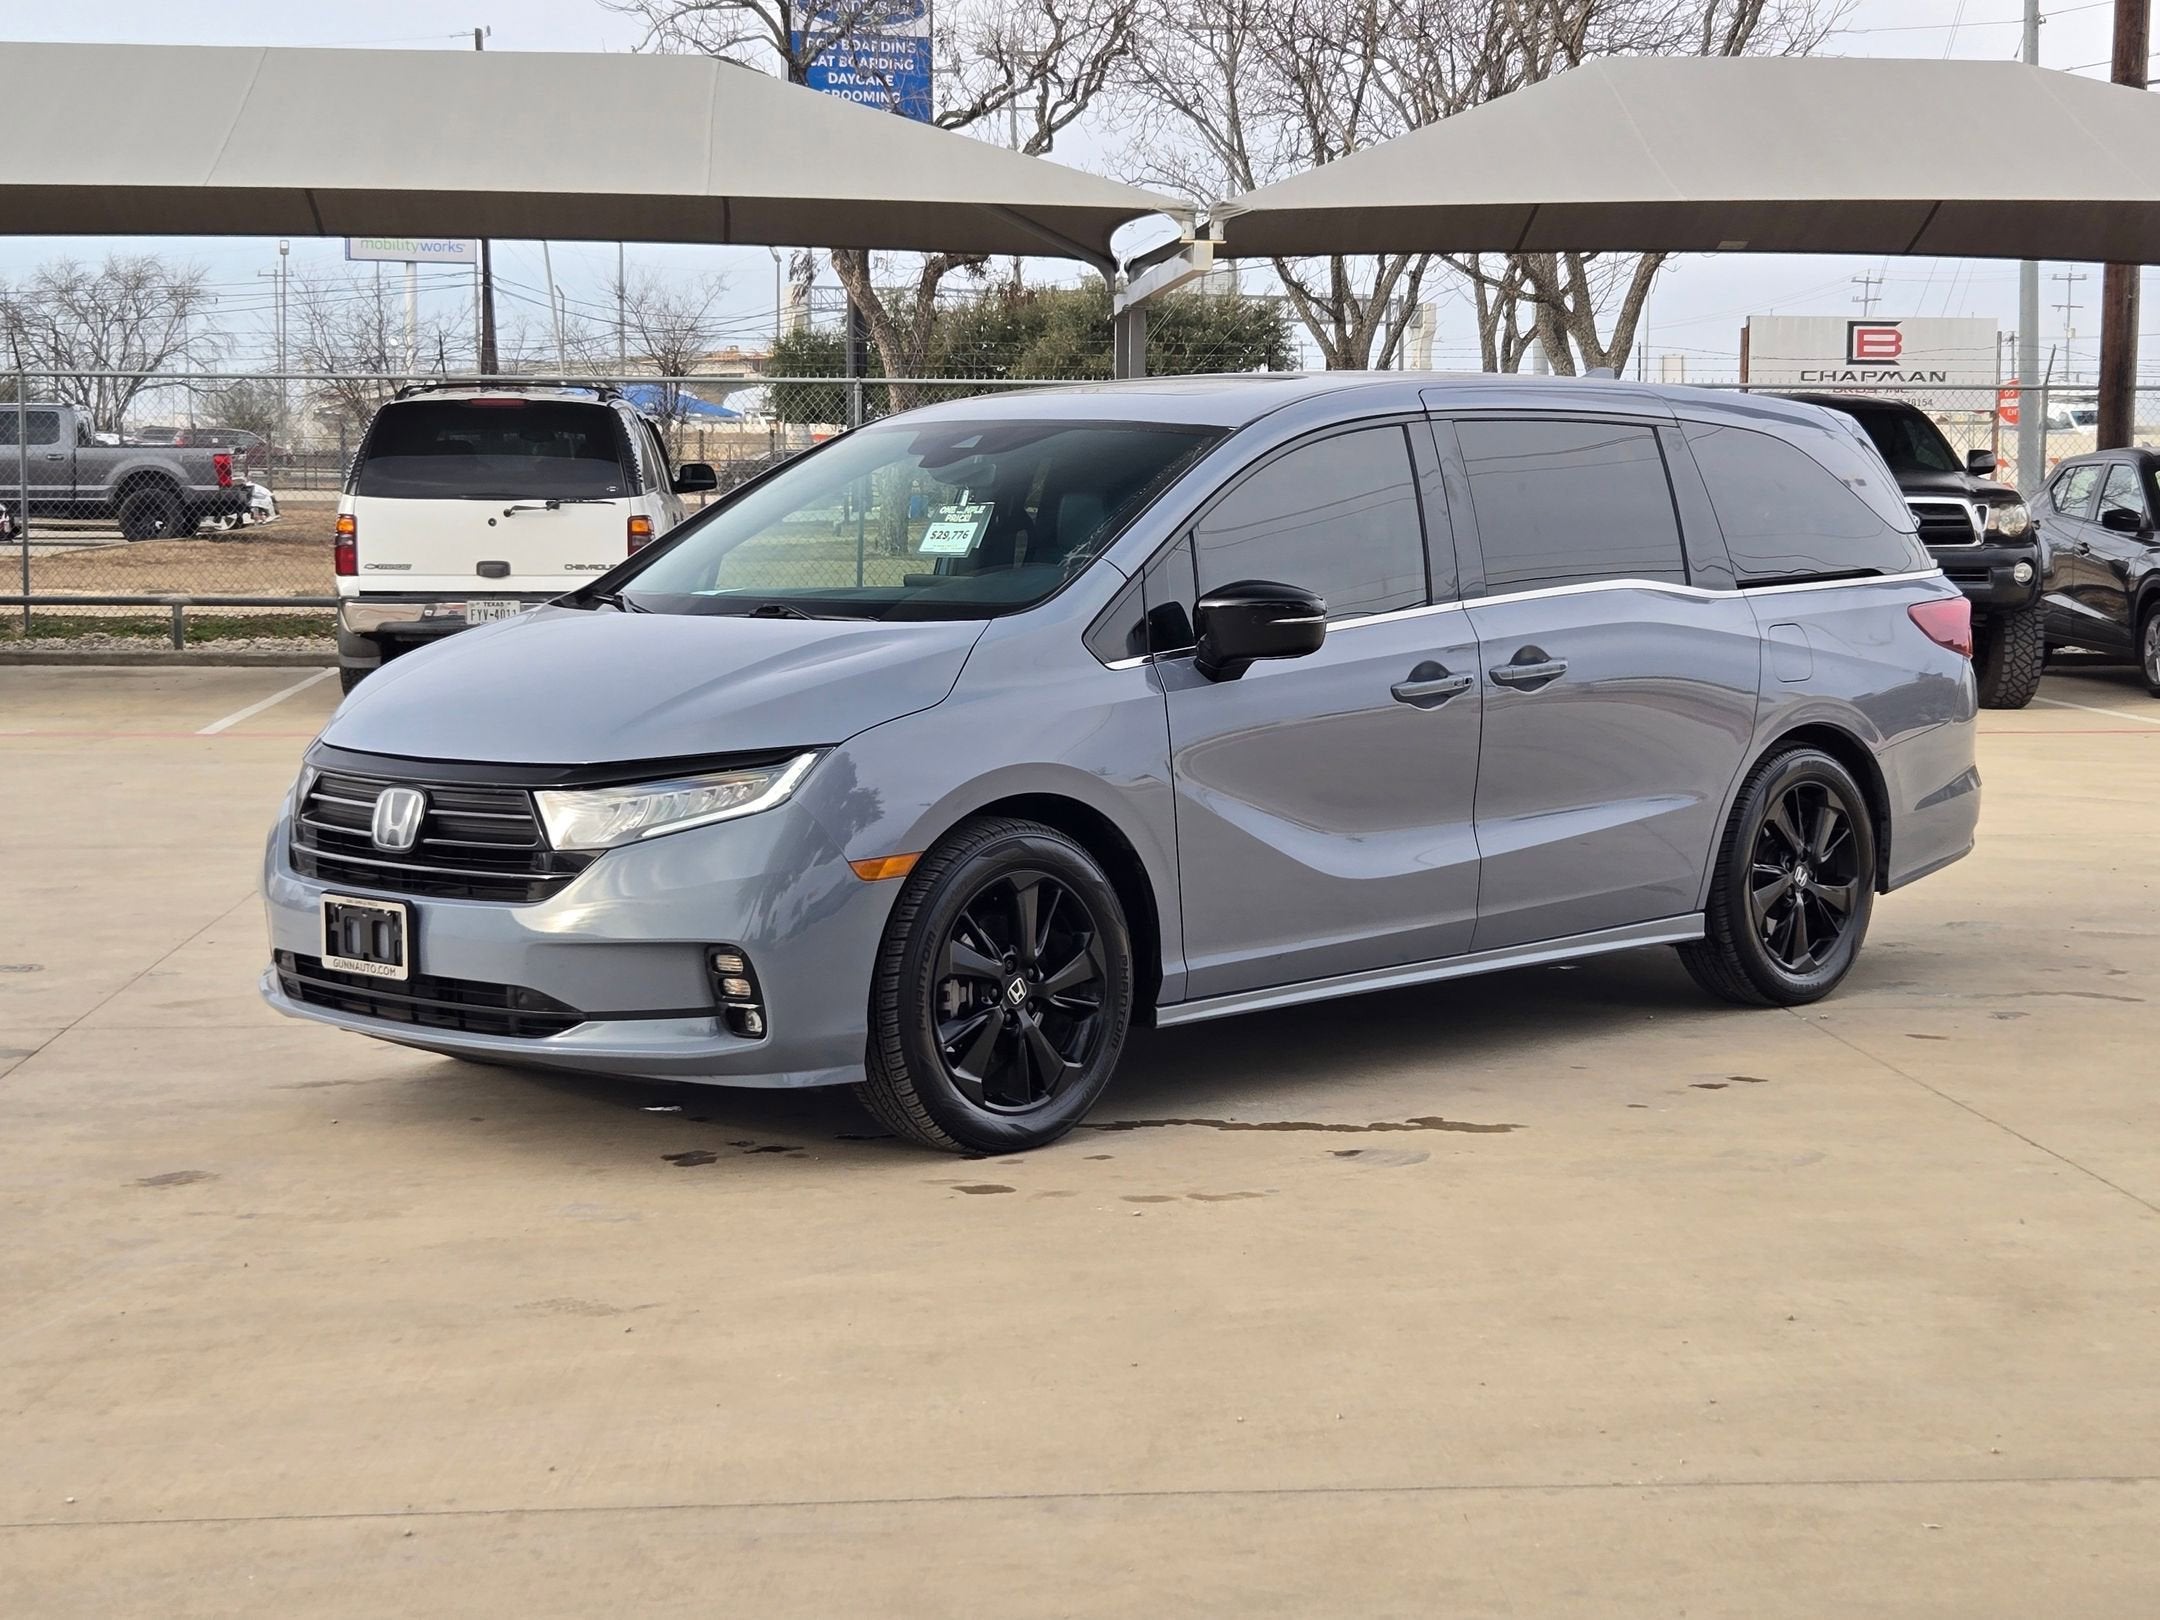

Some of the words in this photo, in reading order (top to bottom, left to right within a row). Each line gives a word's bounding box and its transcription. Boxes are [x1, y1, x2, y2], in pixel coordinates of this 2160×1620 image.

[810, 55, 836, 67] AT
[361, 239, 464, 254] mobilityworks
[1800, 370, 1947, 382] CHAPMAN
[939, 506, 958, 514] ONE
[957, 505, 986, 514] MPLE
[929, 531, 970, 541] $29,776
[332, 958, 397, 977] GUNNAUTO.COM
